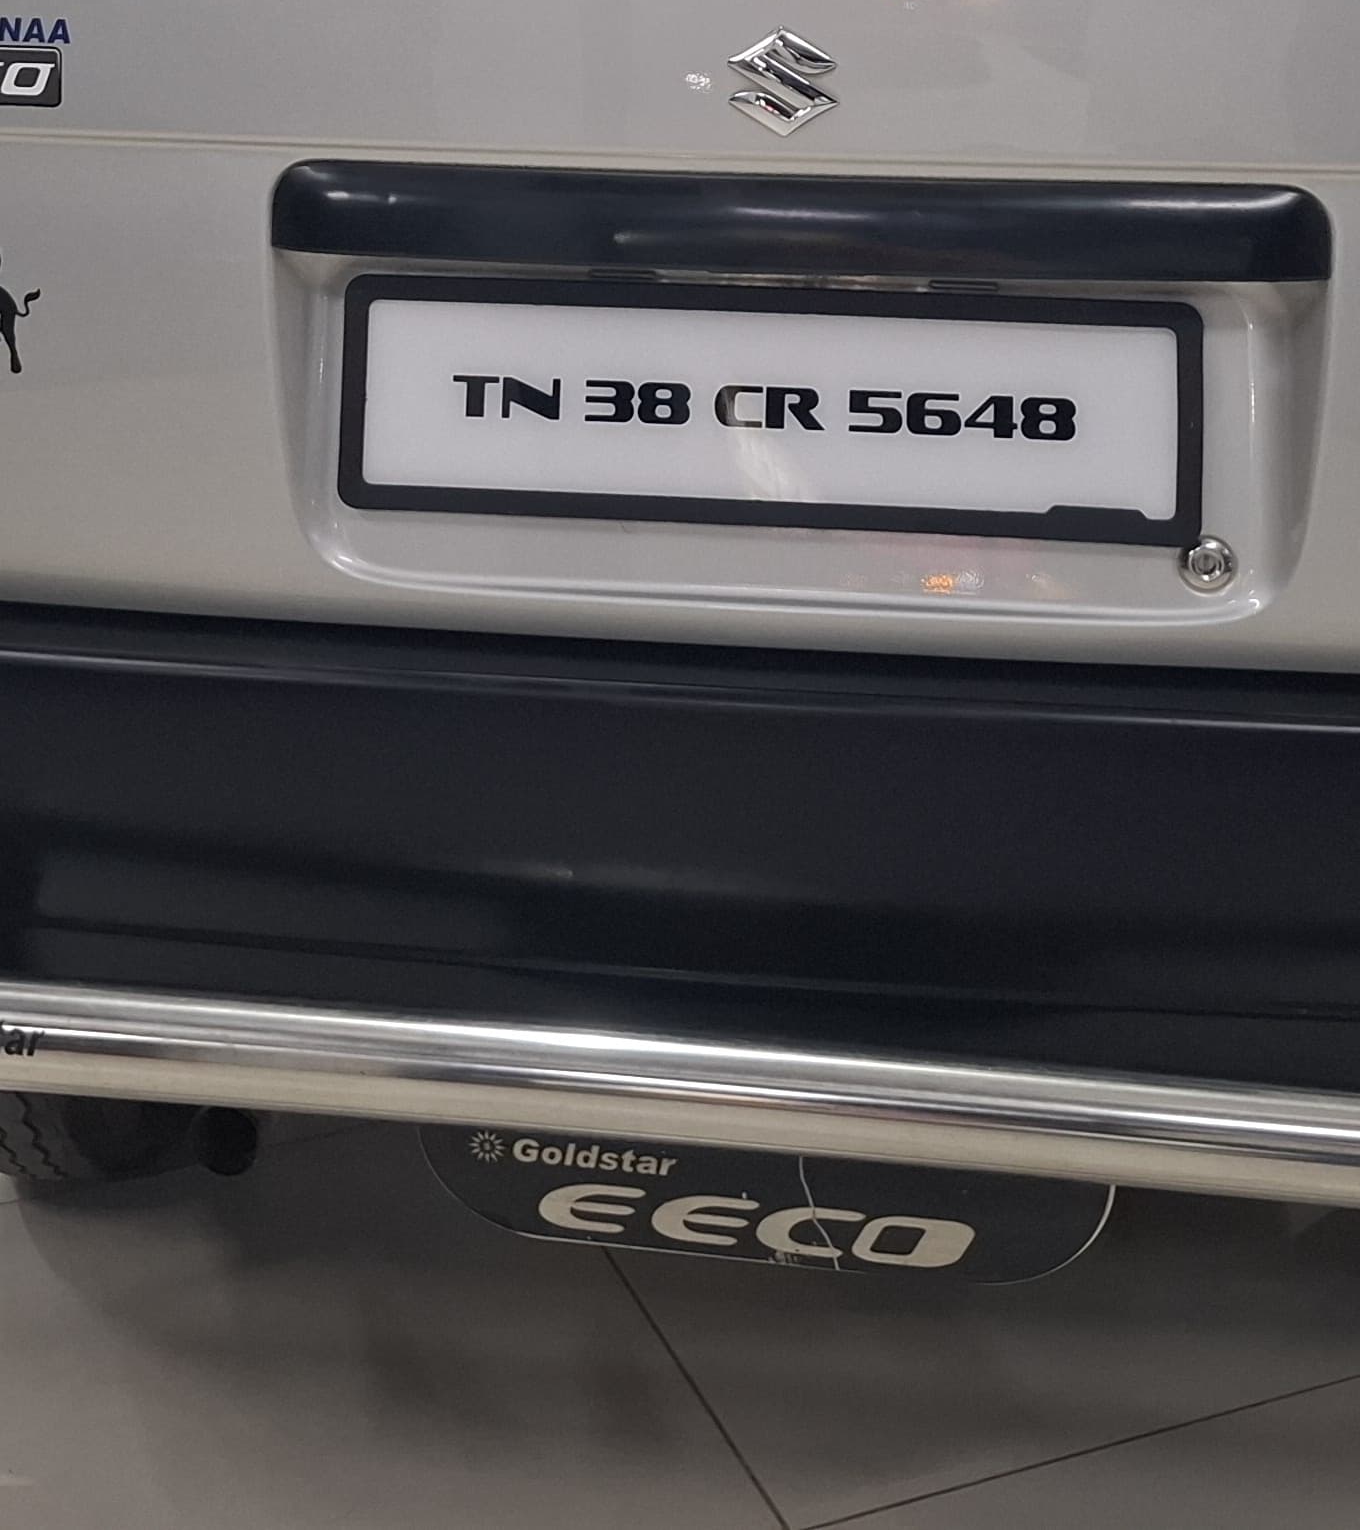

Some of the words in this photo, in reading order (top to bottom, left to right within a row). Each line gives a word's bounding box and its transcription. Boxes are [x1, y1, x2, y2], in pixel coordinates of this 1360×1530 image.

[452, 374, 561, 421] TN
[584, 378, 692, 426] 38
[714, 384, 826, 432] CR
[847, 389, 1078, 442] 5648
[511, 1137, 677, 1177] Goldstar
[538, 1182, 977, 1269] EECO
